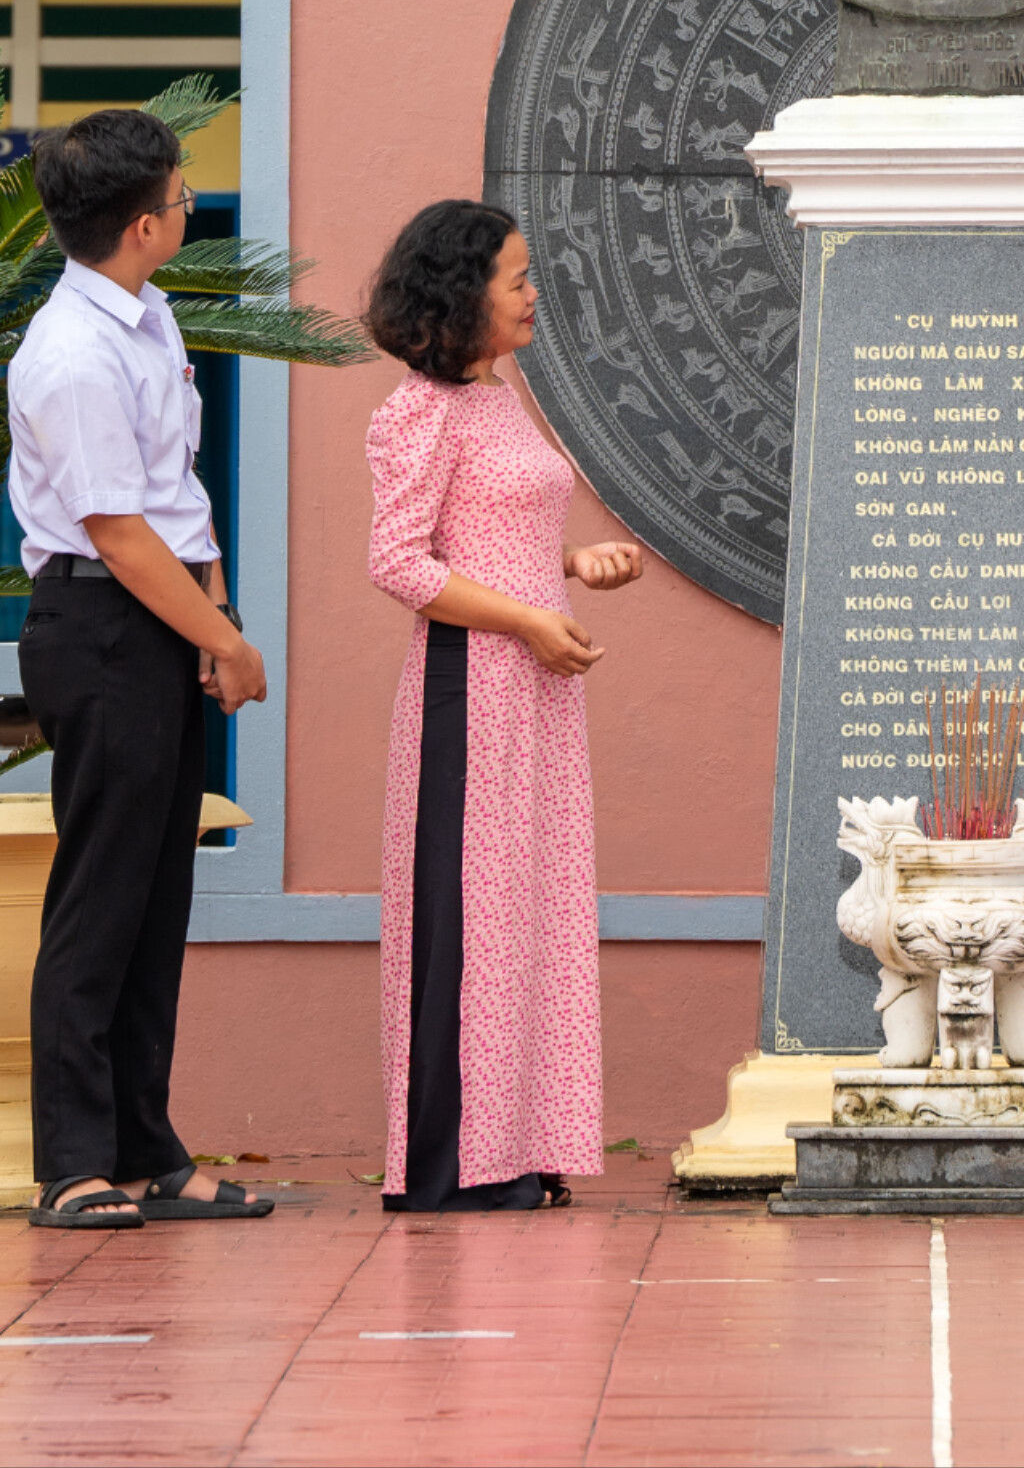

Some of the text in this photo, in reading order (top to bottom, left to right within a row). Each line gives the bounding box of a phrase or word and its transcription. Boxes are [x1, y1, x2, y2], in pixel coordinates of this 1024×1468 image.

[951, 310, 1018, 329] HUỲNH
[854, 342, 914, 360] NGƯỜI
[921, 342, 948, 360] MÀ
[954, 340, 1000, 360] GIÀU
[854, 373, 922, 392] KHÔNG
[945, 373, 984, 391] LÀM
[934, 403, 1001, 422] NGHÈO
[854, 435, 924, 454] KHÔNG
[929, 435, 969, 454] LÀM
[974, 433, 1014, 453] NẢN
[855, 470, 888, 486] OAI
[899, 467, 926, 485] VŨ
[937, 467, 1005, 485] KHÔNG
[855, 498, 895, 517] SỜN
[871, 528, 897, 547] CẢ
[908, 528, 941, 547] ĐỜI
[958, 532, 984, 550] CỤ
[850, 561, 919, 579] KHÔNG
[929, 557, 969, 579] CẦU
[845, 592, 913, 611] KHÔNG
[930, 589, 969, 611] CẦU
[980, 595, 1011, 613] LỢI
[845, 624, 914, 642] KHÔNG
[978, 622, 1017, 641] LÀM
[840, 655, 909, 674] KHÔNG
[914, 654, 968, 673] THÈM
[973, 653, 1012, 672] LÀM
[840, 685, 867, 706] CẢ
[872, 686, 904, 706] ĐỜI
[910, 692, 937, 708] CỤ
[944, 682, 976, 705] CH
[840, 722, 882, 737] CHO
[893, 718, 931, 736] DÂN
[842, 749, 897, 768] NƯỚC
